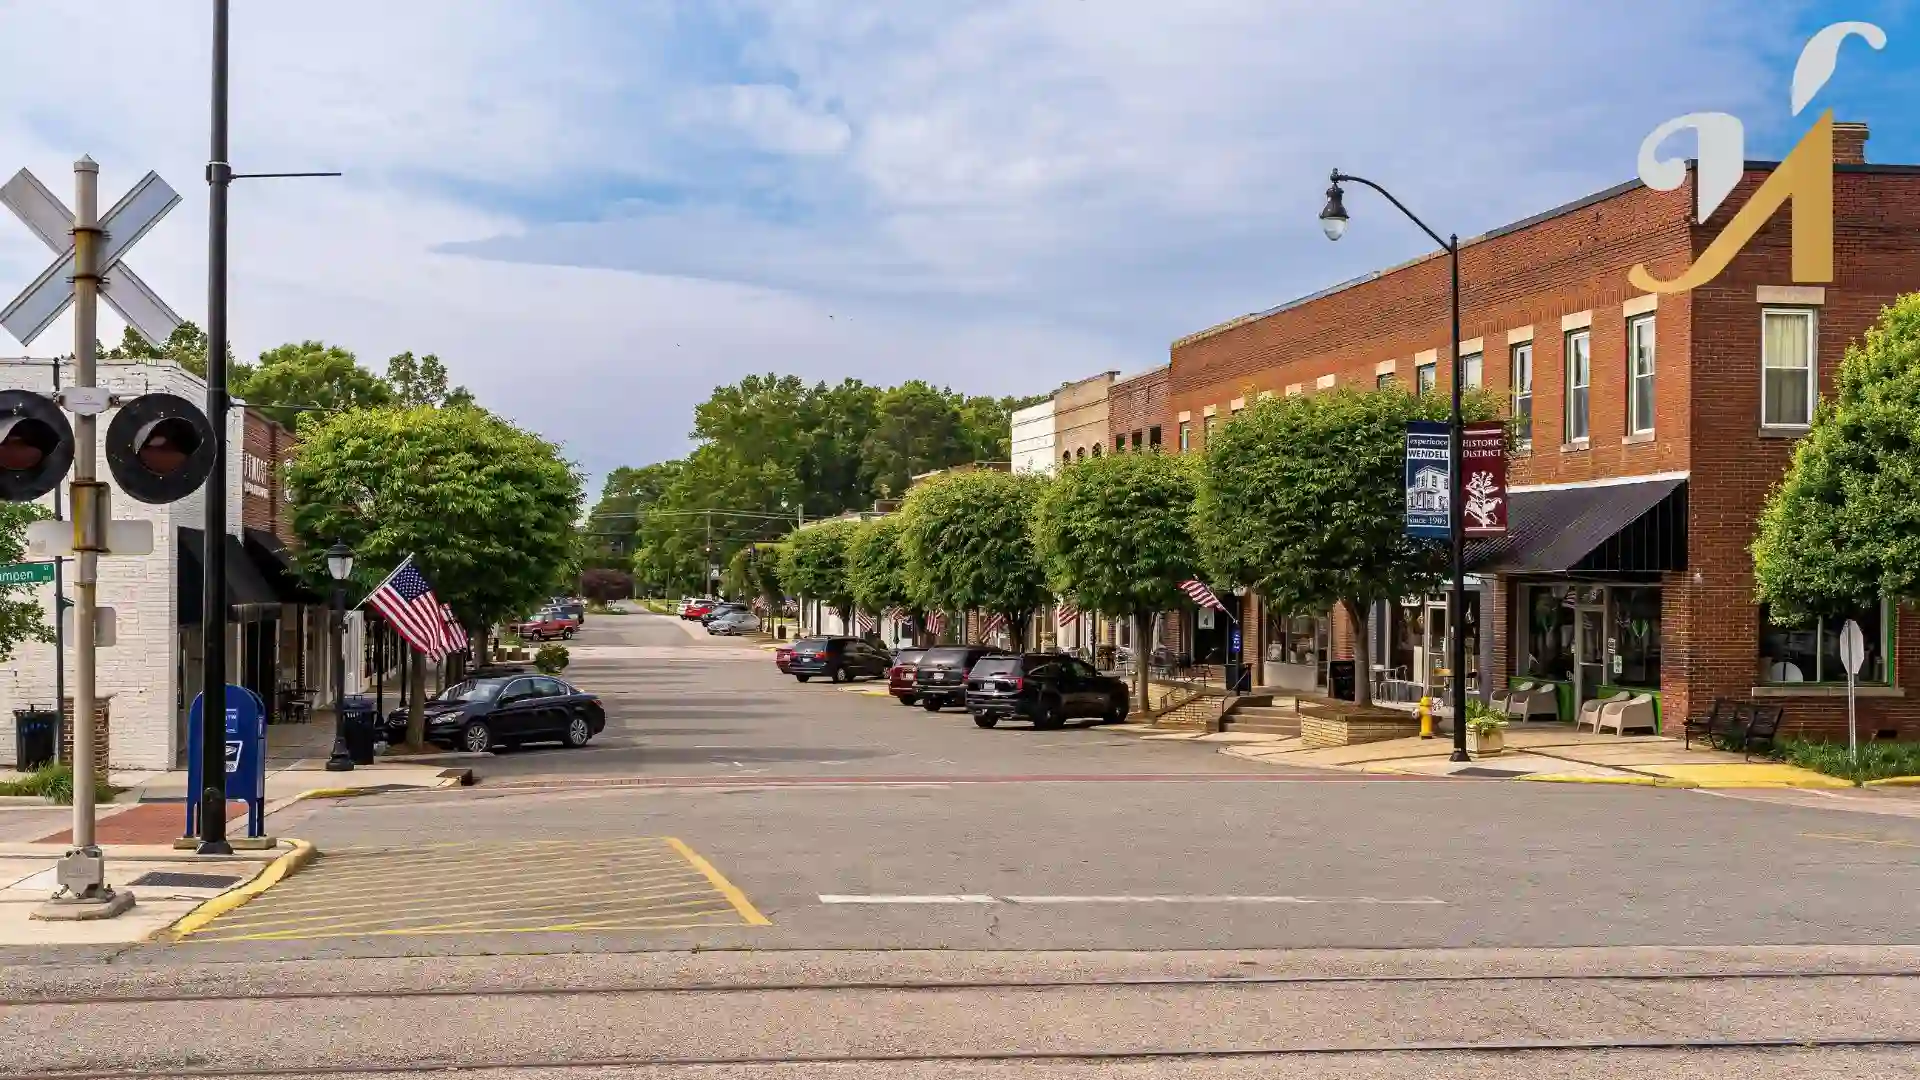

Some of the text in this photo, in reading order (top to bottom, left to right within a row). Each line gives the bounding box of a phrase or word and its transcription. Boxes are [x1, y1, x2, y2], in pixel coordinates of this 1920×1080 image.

[1409, 438, 1448, 446] experience
[1463, 438, 1503, 447] HISTORIC
[1408, 450, 1448, 458] WENDELL
[1463, 450, 1501, 458] DISTRICT
[0, 571, 33, 582] mpen
